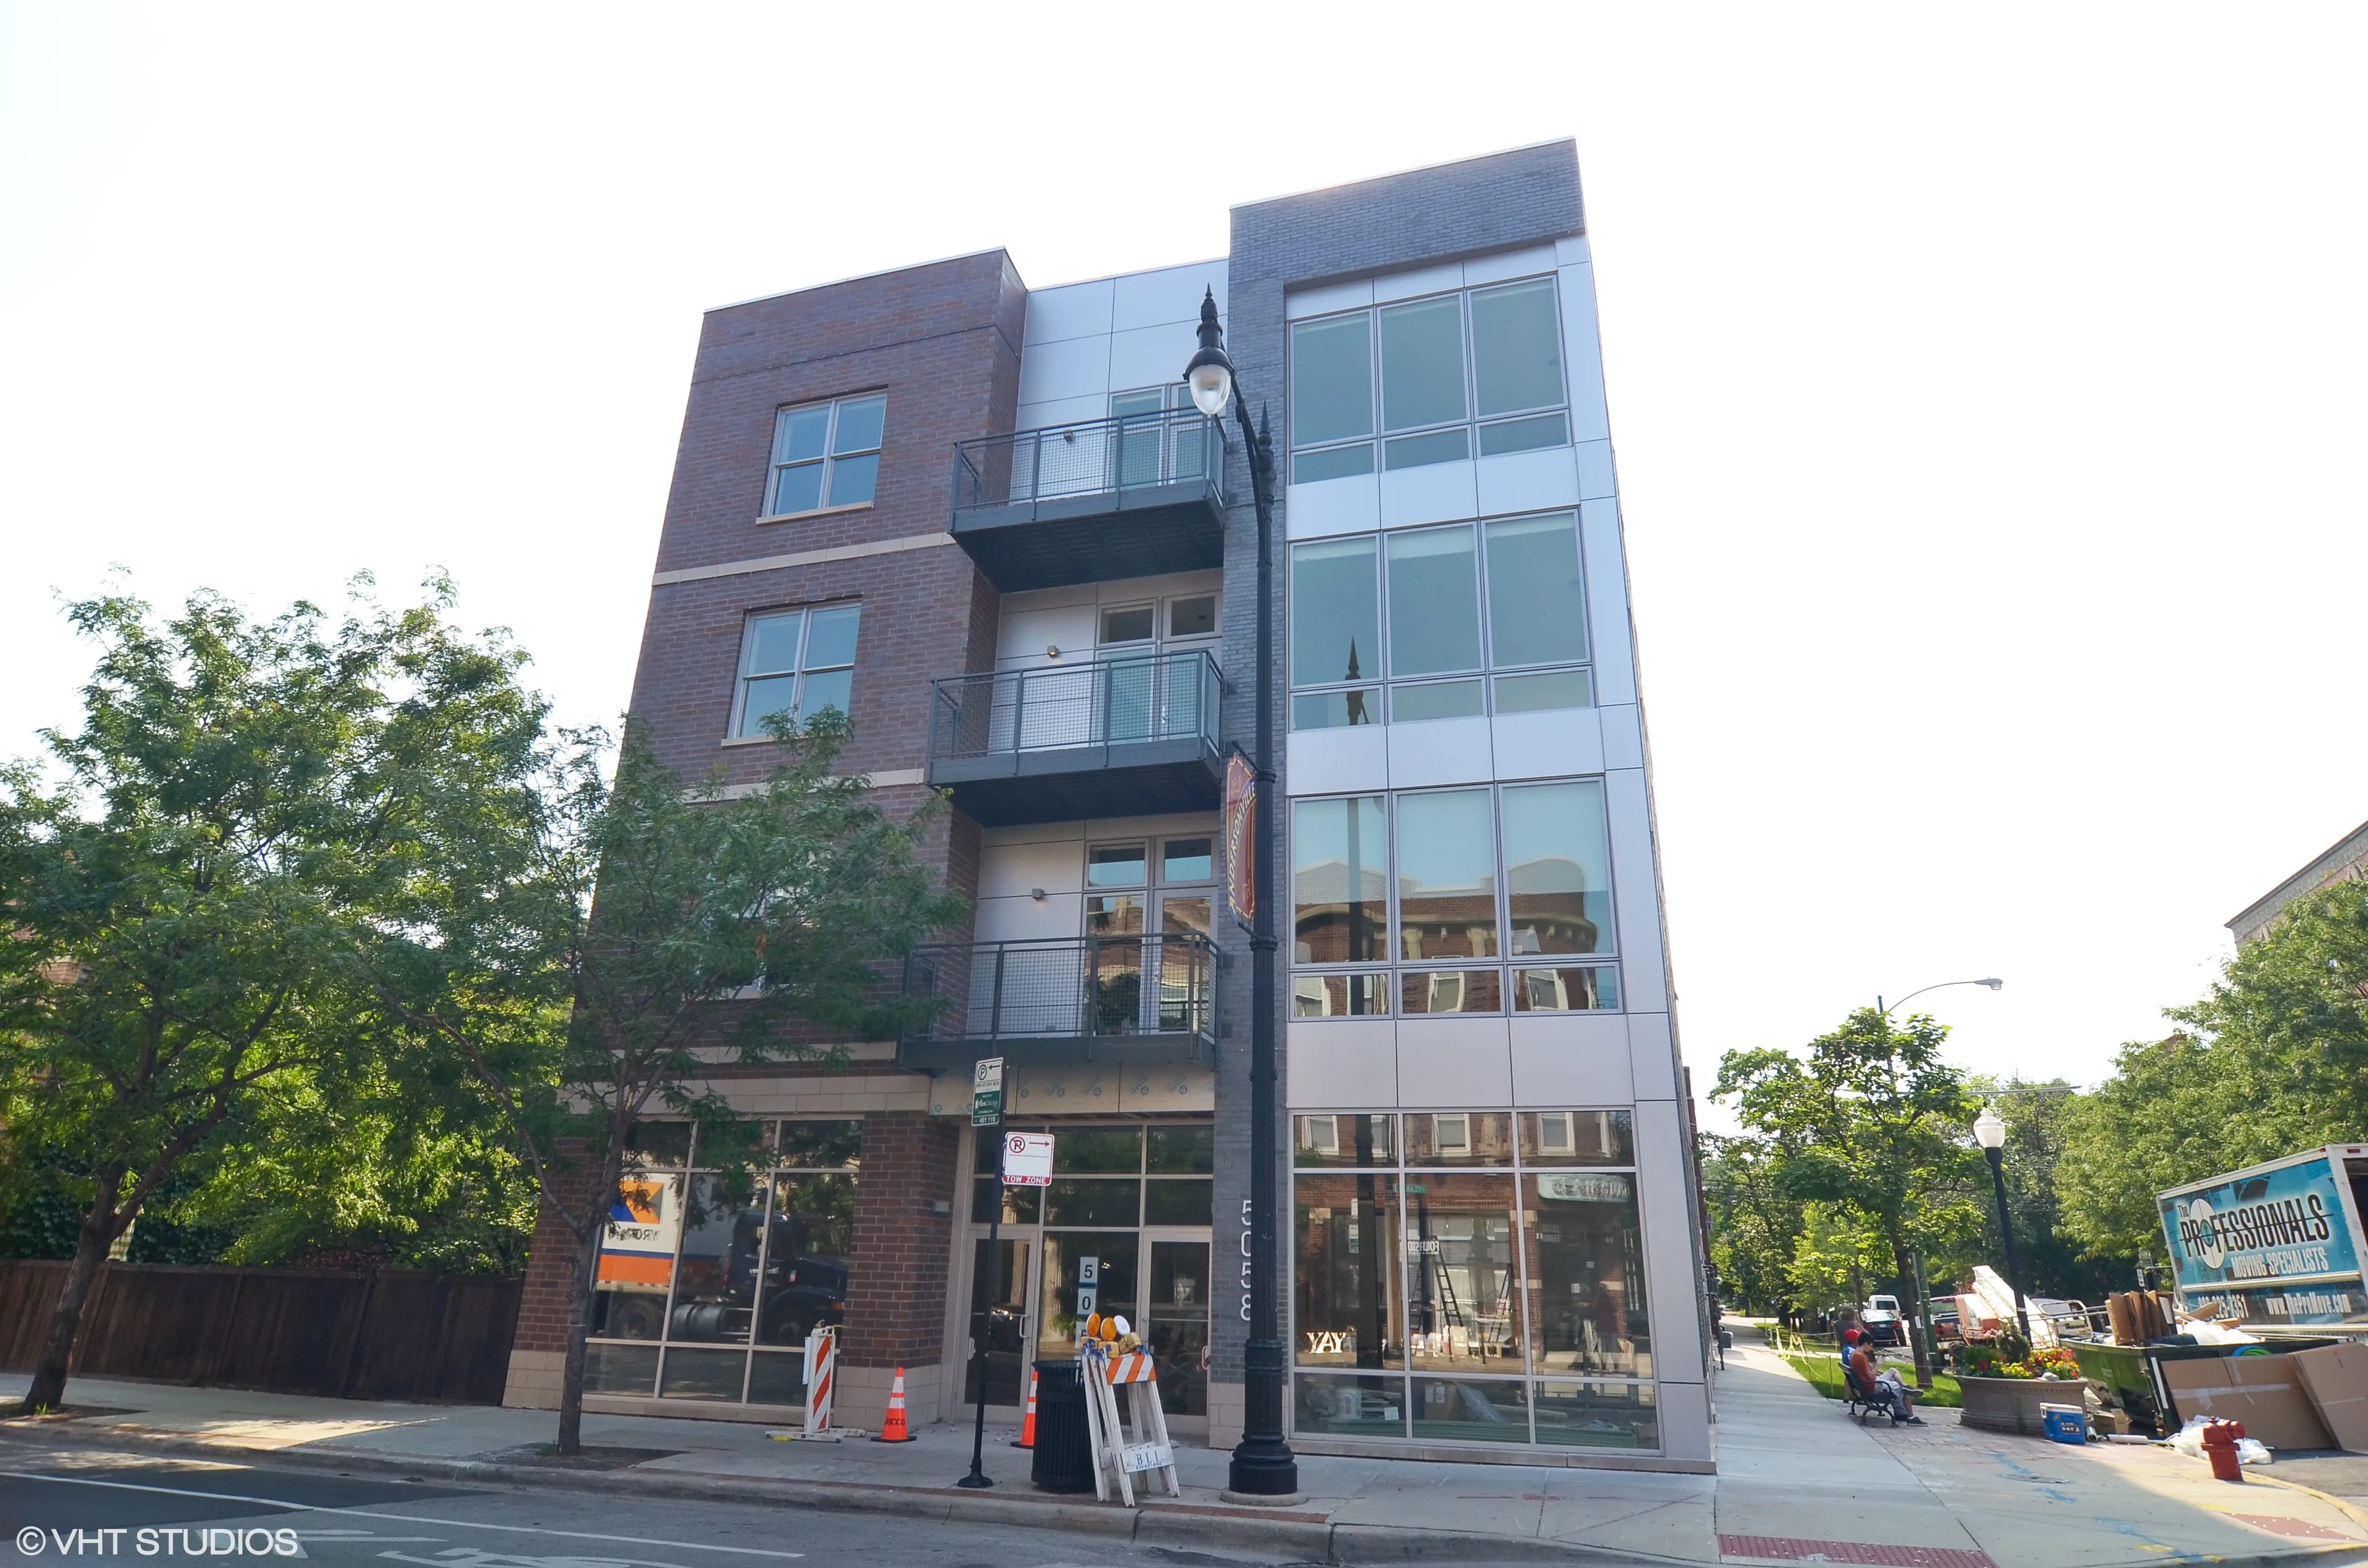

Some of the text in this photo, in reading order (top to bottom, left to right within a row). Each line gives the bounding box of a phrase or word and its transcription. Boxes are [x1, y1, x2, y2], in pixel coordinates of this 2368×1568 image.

[1228, 781, 1256, 915] ANDERSONVILLE
[2178, 1204, 2189, 1218] The
[2180, 1195, 2330, 1257] PROFESSIONALS
[2231, 1246, 2330, 1278] MOVING SPECIALISTS
[2265, 1292, 2351, 1315] www.TheProMove.com
[1306, 1331, 1347, 1354] YAY
